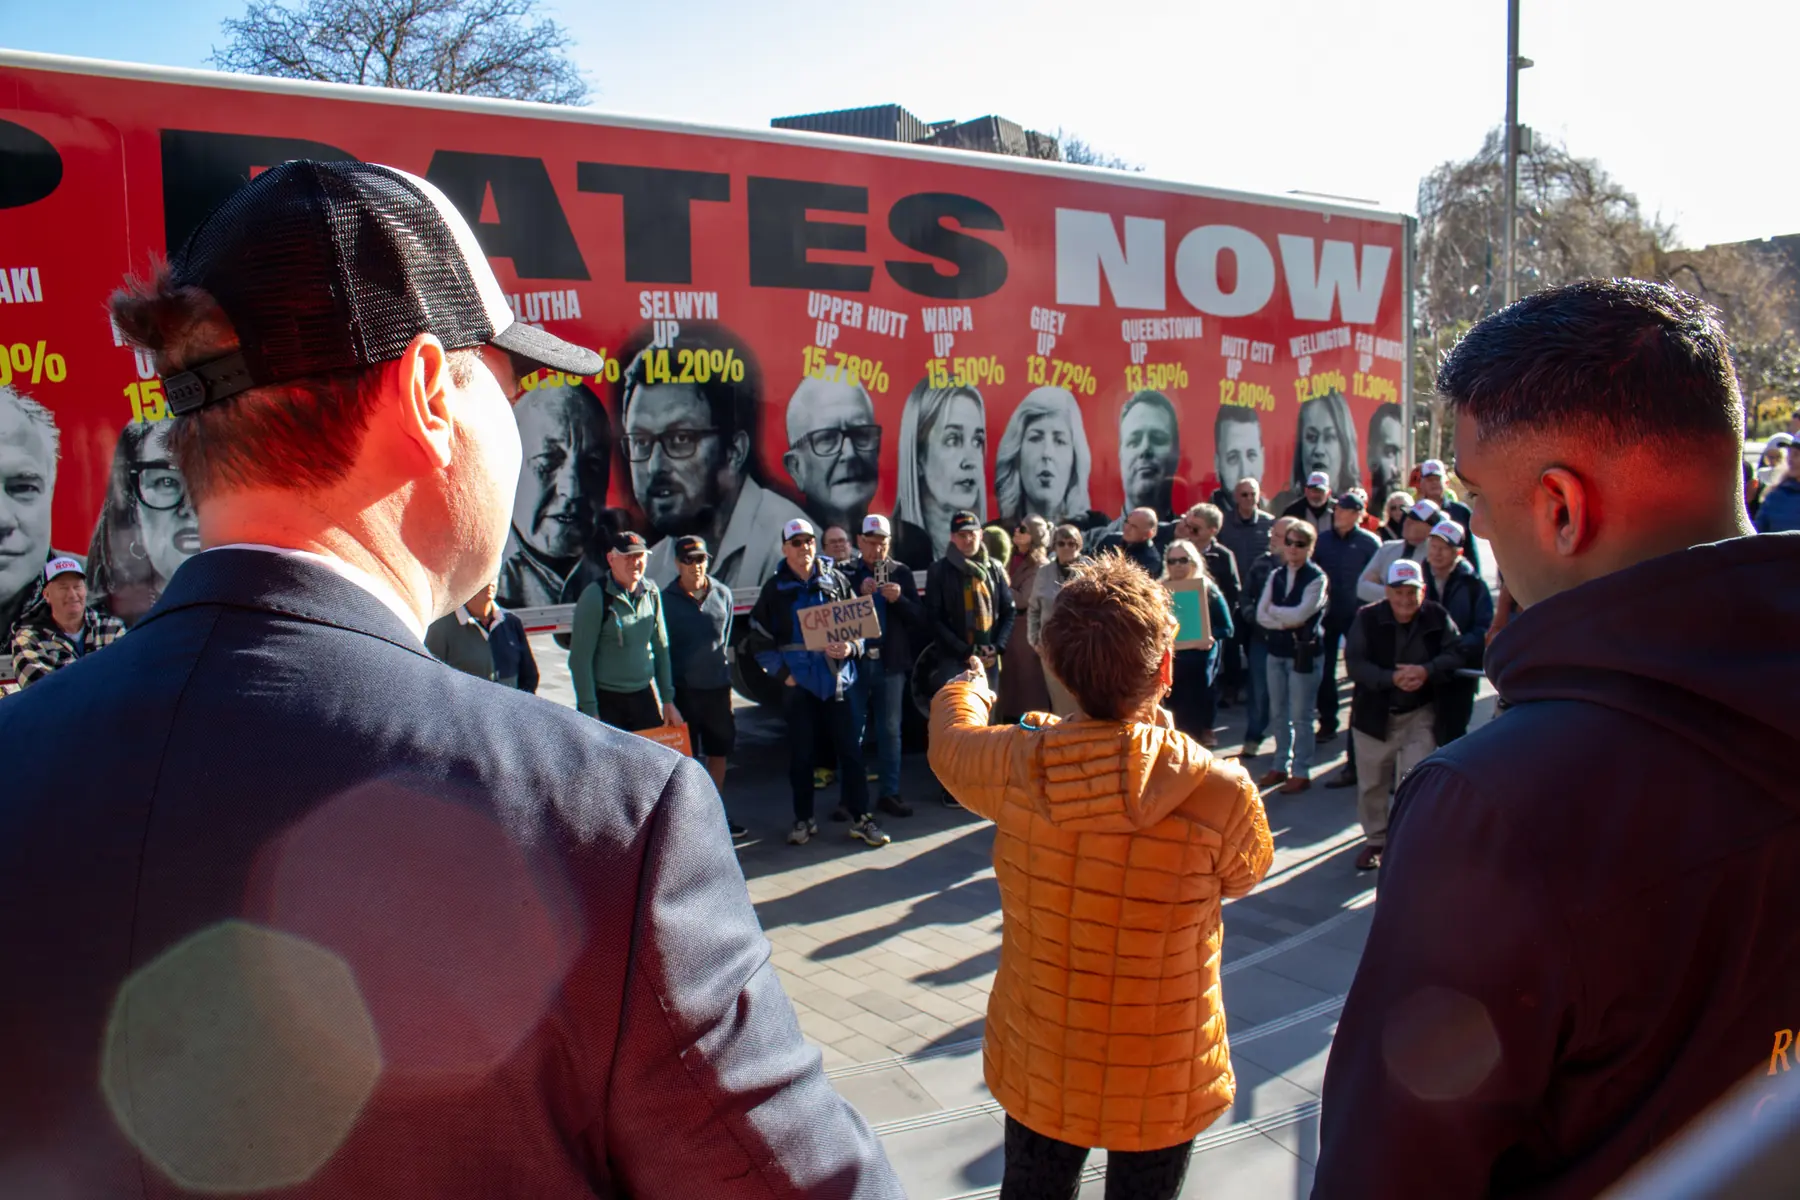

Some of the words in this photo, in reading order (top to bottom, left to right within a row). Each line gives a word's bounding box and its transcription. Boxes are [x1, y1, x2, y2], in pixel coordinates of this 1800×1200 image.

[1055, 207, 1393, 324] NOW
[640, 290, 718, 319] SELWYN
[808, 291, 864, 328] UPPER
[866, 306, 909, 339] HUTT
[653, 320, 679, 348] UP
[815, 320, 839, 348] UP
[922, 306, 973, 333] WAIPA
[1030, 306, 1066, 335] GREY
[1121, 317, 1202, 343] QUEENSTOWN
[933, 333, 954, 357] UP
[1037, 332, 1056, 356] UP
[1130, 342, 1148, 364] UP
[1221, 335, 1249, 360] HUTT
[1251, 341, 1275, 364] CITY
[1291, 326, 1351, 358] WELLINGTON
[642, 348, 745, 384] 14.20%
[802, 345, 889, 393] 15.78%
[925, 355, 1005, 389] 15.50%
[1027, 355, 1097, 395] 13.72%
[1124, 362, 1188, 392] 13.50%
[1226, 357, 1242, 379] UP
[1219, 378, 1275, 411] 12.80%
[1294, 368, 1346, 403] 12.00%
[803, 608, 831, 631] CAP
[832, 601, 873, 625] RATES
[826, 623, 863, 643] NOW
